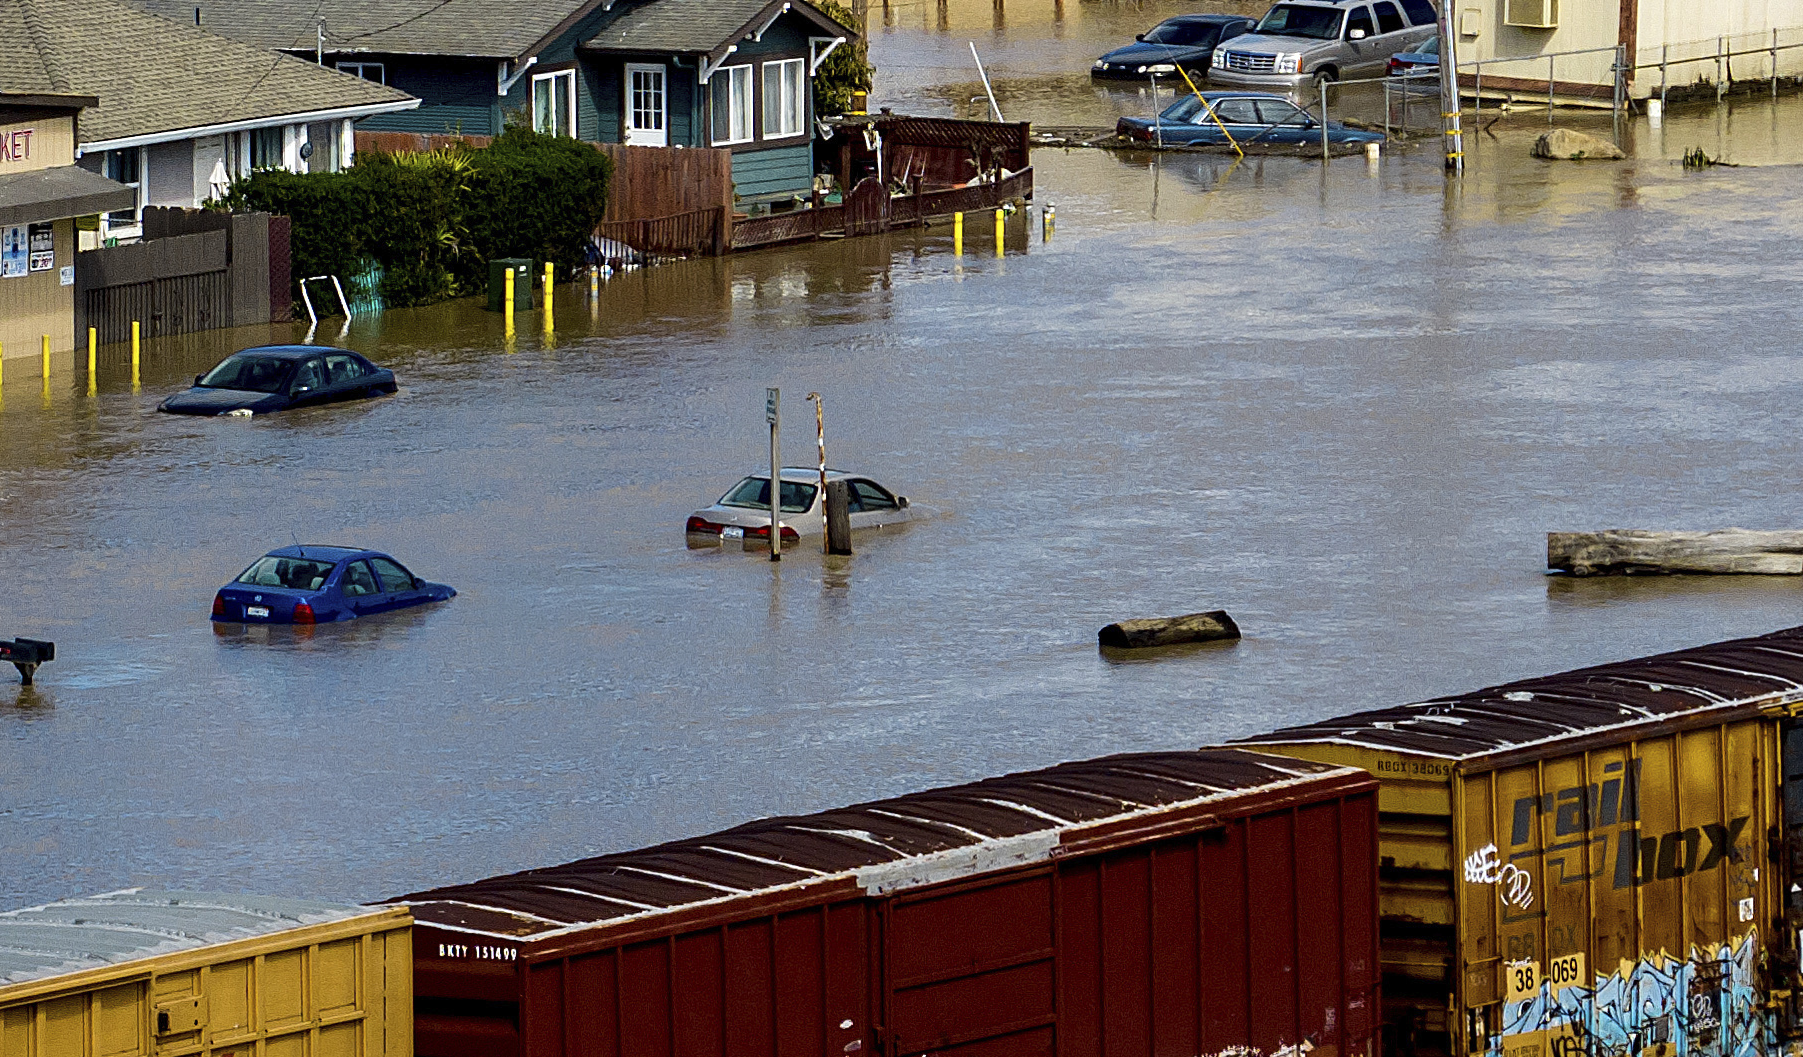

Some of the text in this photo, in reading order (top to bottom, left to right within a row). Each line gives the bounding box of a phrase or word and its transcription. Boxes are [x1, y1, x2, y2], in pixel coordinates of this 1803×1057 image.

[1510, 756, 1642, 847] rail
[1613, 815, 1750, 891] box
[439, 943, 517, 962] BKTY 151499
[1515, 956, 1578, 993] 38 069
